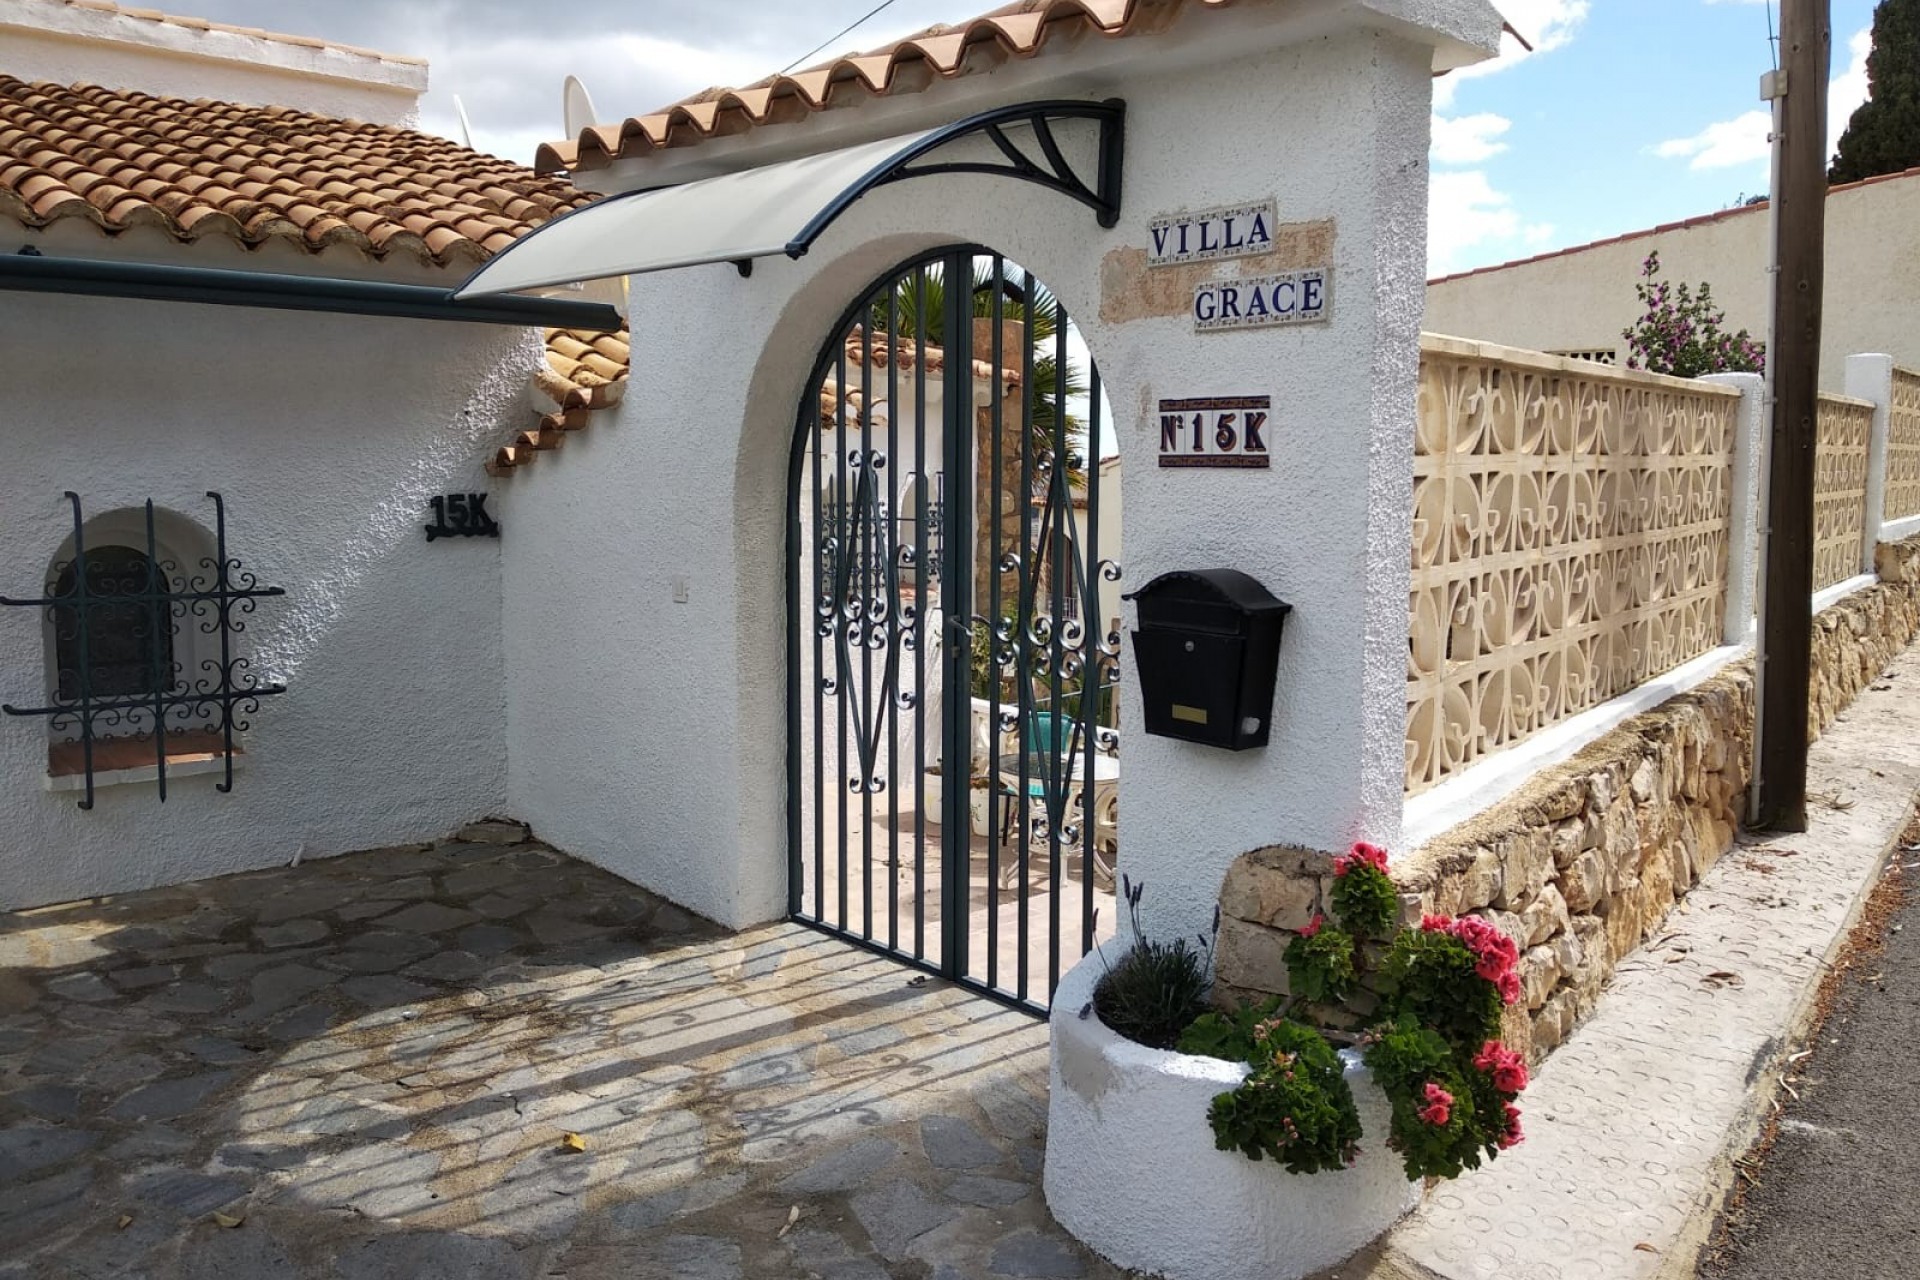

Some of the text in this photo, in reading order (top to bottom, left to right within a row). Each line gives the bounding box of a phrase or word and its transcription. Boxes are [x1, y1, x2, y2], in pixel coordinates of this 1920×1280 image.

[1151, 213, 1270, 256] VILLA
[1195, 279, 1323, 321] GRACE
[430, 493, 497, 530] 15K
